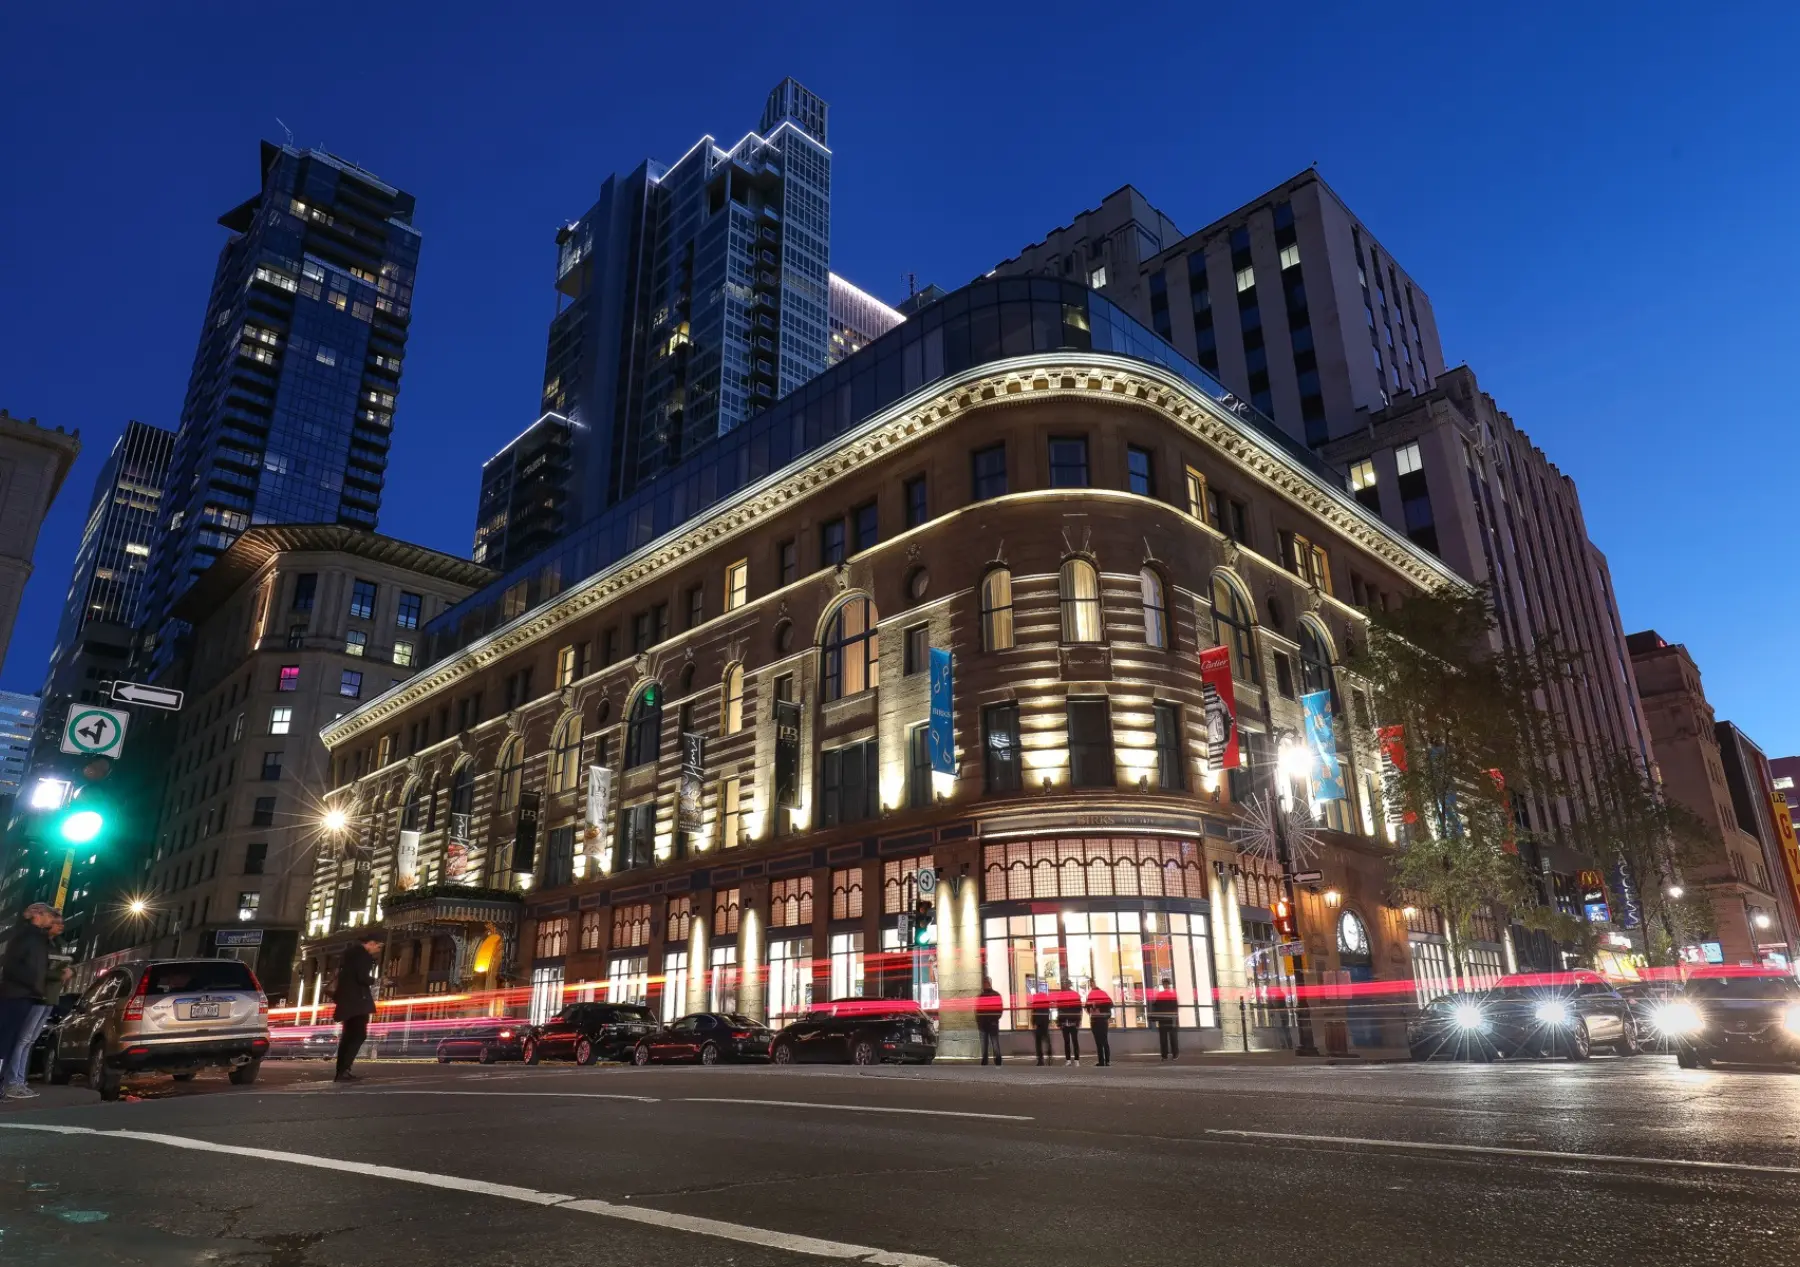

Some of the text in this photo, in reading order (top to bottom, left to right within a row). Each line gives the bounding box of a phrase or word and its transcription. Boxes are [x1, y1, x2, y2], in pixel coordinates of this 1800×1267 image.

[1201, 660, 1229, 670] Cartier
[1771, 793, 1786, 803] LE
[1077, 815, 1115, 825] BIRKS
